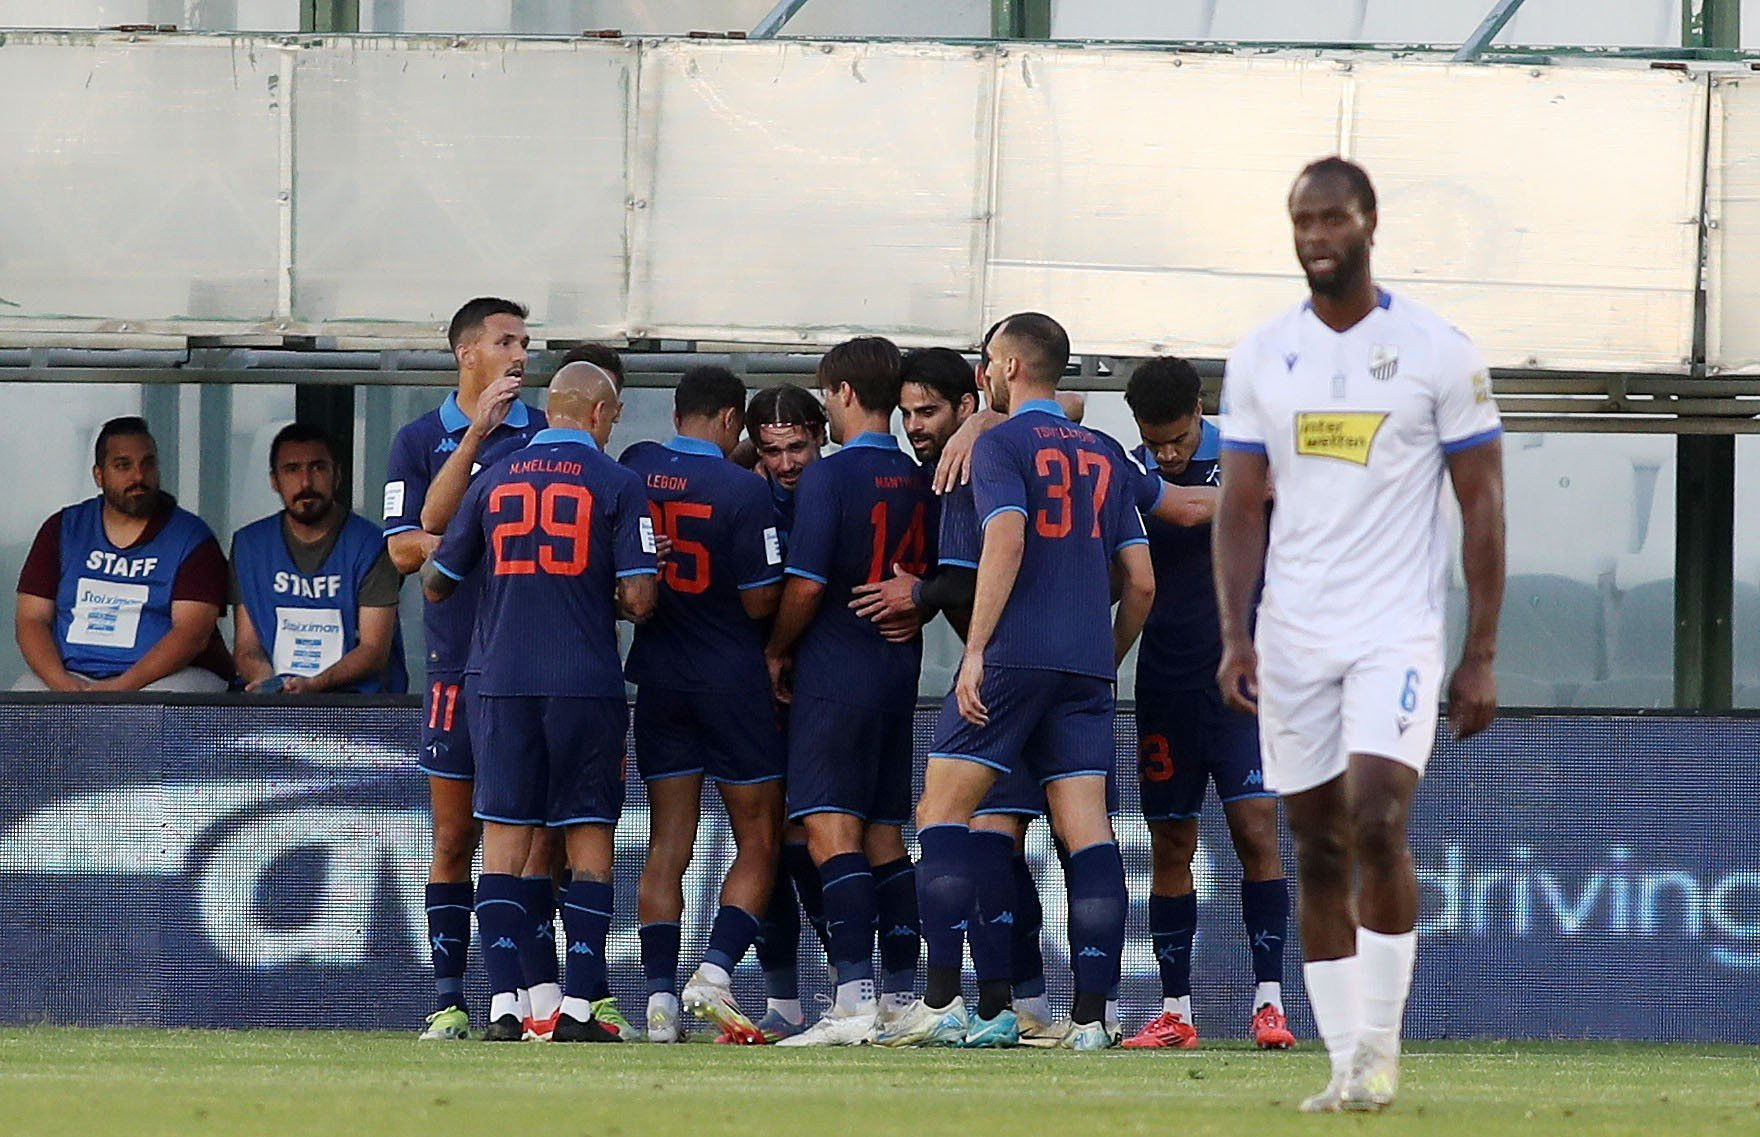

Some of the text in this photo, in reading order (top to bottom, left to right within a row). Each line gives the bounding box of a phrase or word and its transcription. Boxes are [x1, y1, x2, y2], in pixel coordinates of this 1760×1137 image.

[647, 473, 688, 491] LEBON
[1035, 448, 1112, 538] 37
[489, 482, 593, 576] 29
[867, 501, 928, 584] 14
[86, 550, 158, 578] STAFF
[273, 571, 341, 599] STAFF
[428, 681, 459, 732] 11
[1401, 668, 1420, 713] 6
